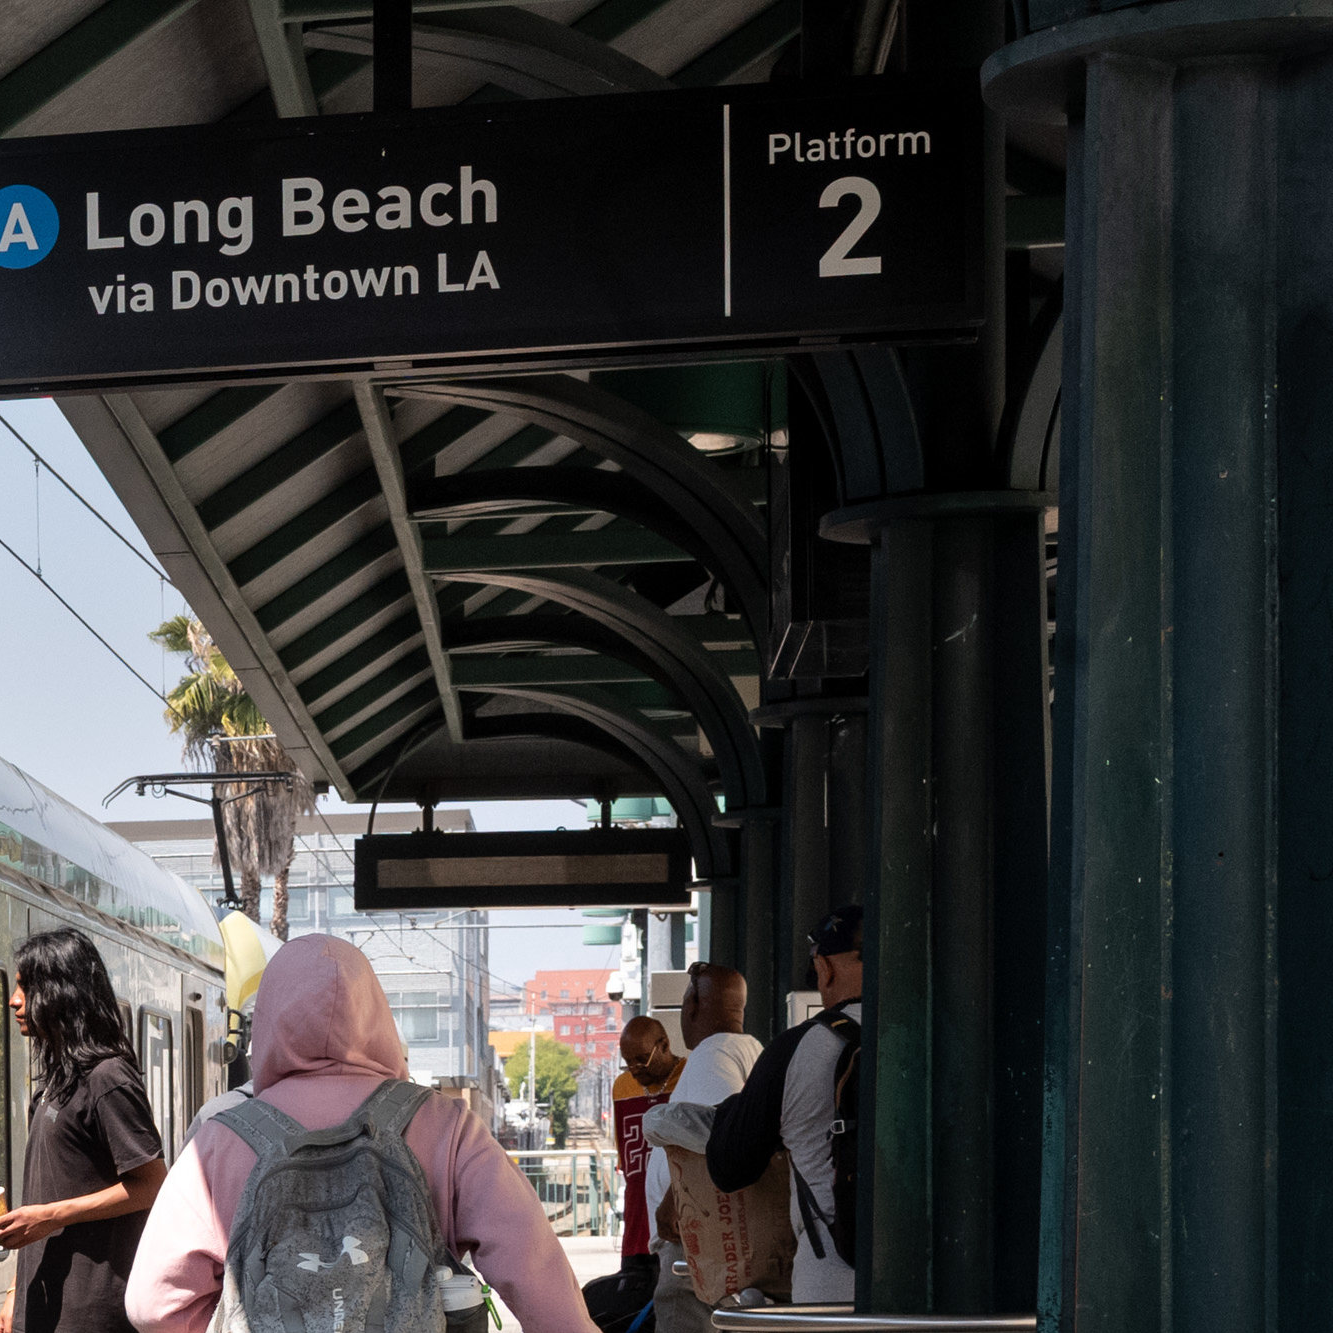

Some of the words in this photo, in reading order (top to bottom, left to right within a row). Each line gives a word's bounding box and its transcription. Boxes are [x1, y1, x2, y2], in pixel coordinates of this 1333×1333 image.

[767, 129, 933, 166] Platform
[85, 190, 255, 257] Long
[281, 166, 499, 239] Beach
[818, 176, 884, 279] 2
[88, 274, 155, 317] via
[171, 249, 421, 312] Downtown
[437, 250, 501, 295] LA
[721, 1230, 739, 1296] TRADER
